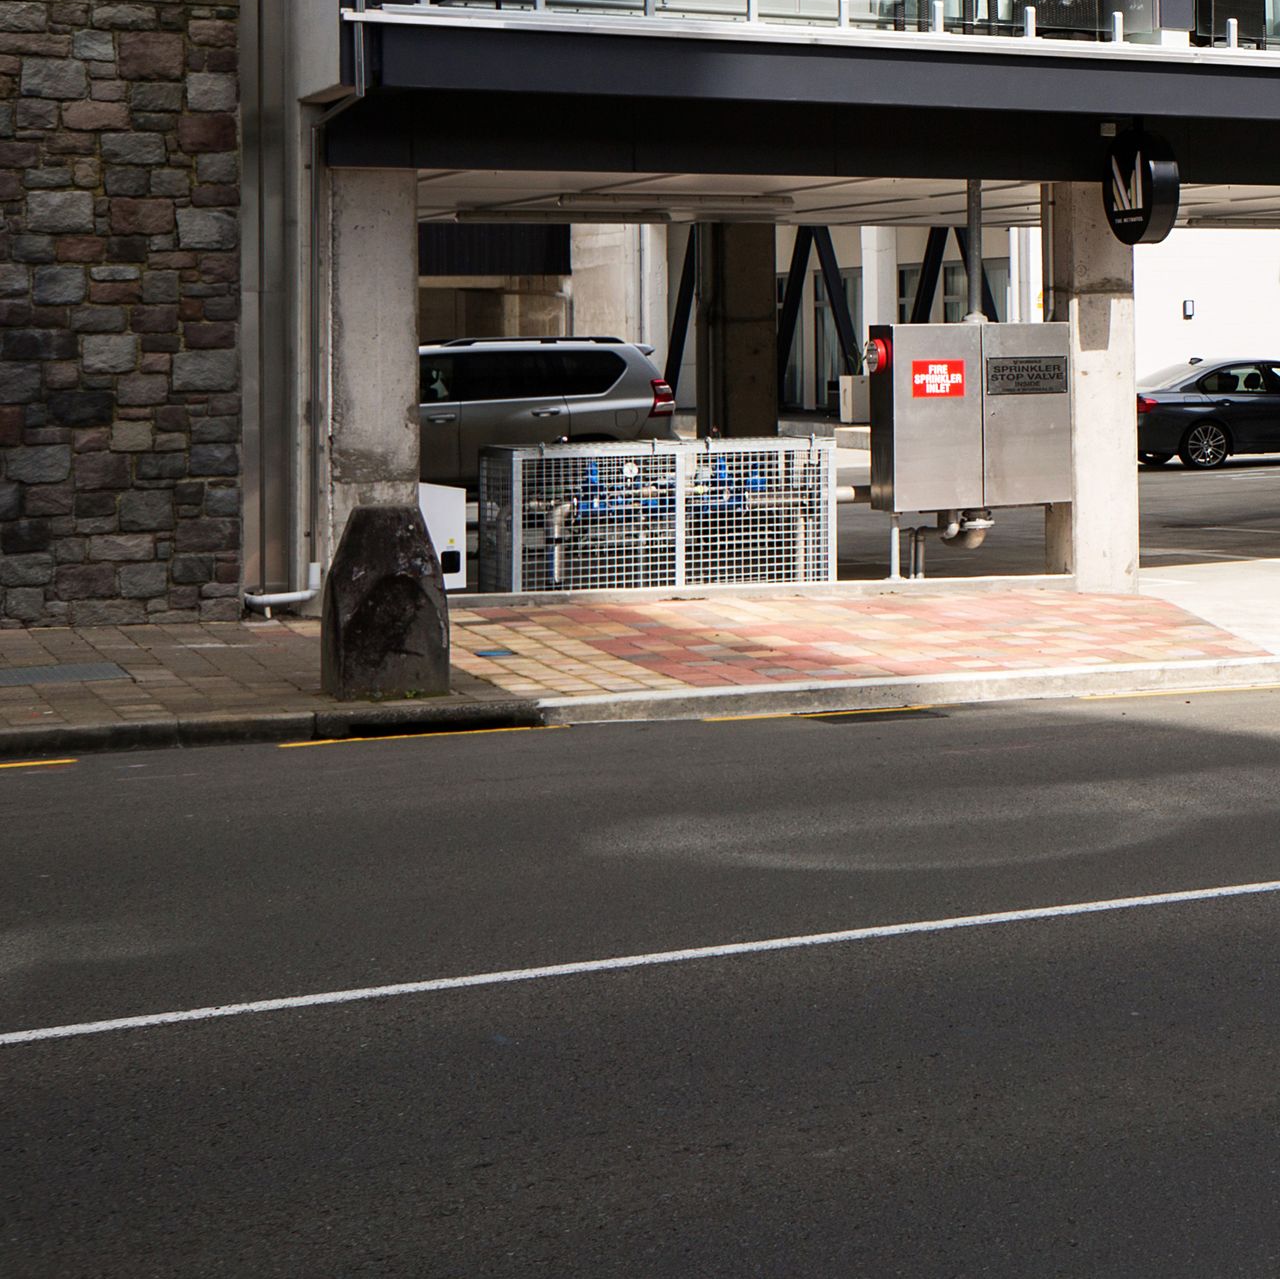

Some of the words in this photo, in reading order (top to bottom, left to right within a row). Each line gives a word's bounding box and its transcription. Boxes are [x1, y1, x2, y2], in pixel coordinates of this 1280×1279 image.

[928, 364, 948, 375] FIRE
[994, 364, 1061, 374] SPRINKLER
[914, 373, 962, 384] SPRINKLER
[991, 373, 1024, 382] STOP
[1027, 372, 1064, 381] VALVE
[926, 383, 951, 394] INLET
